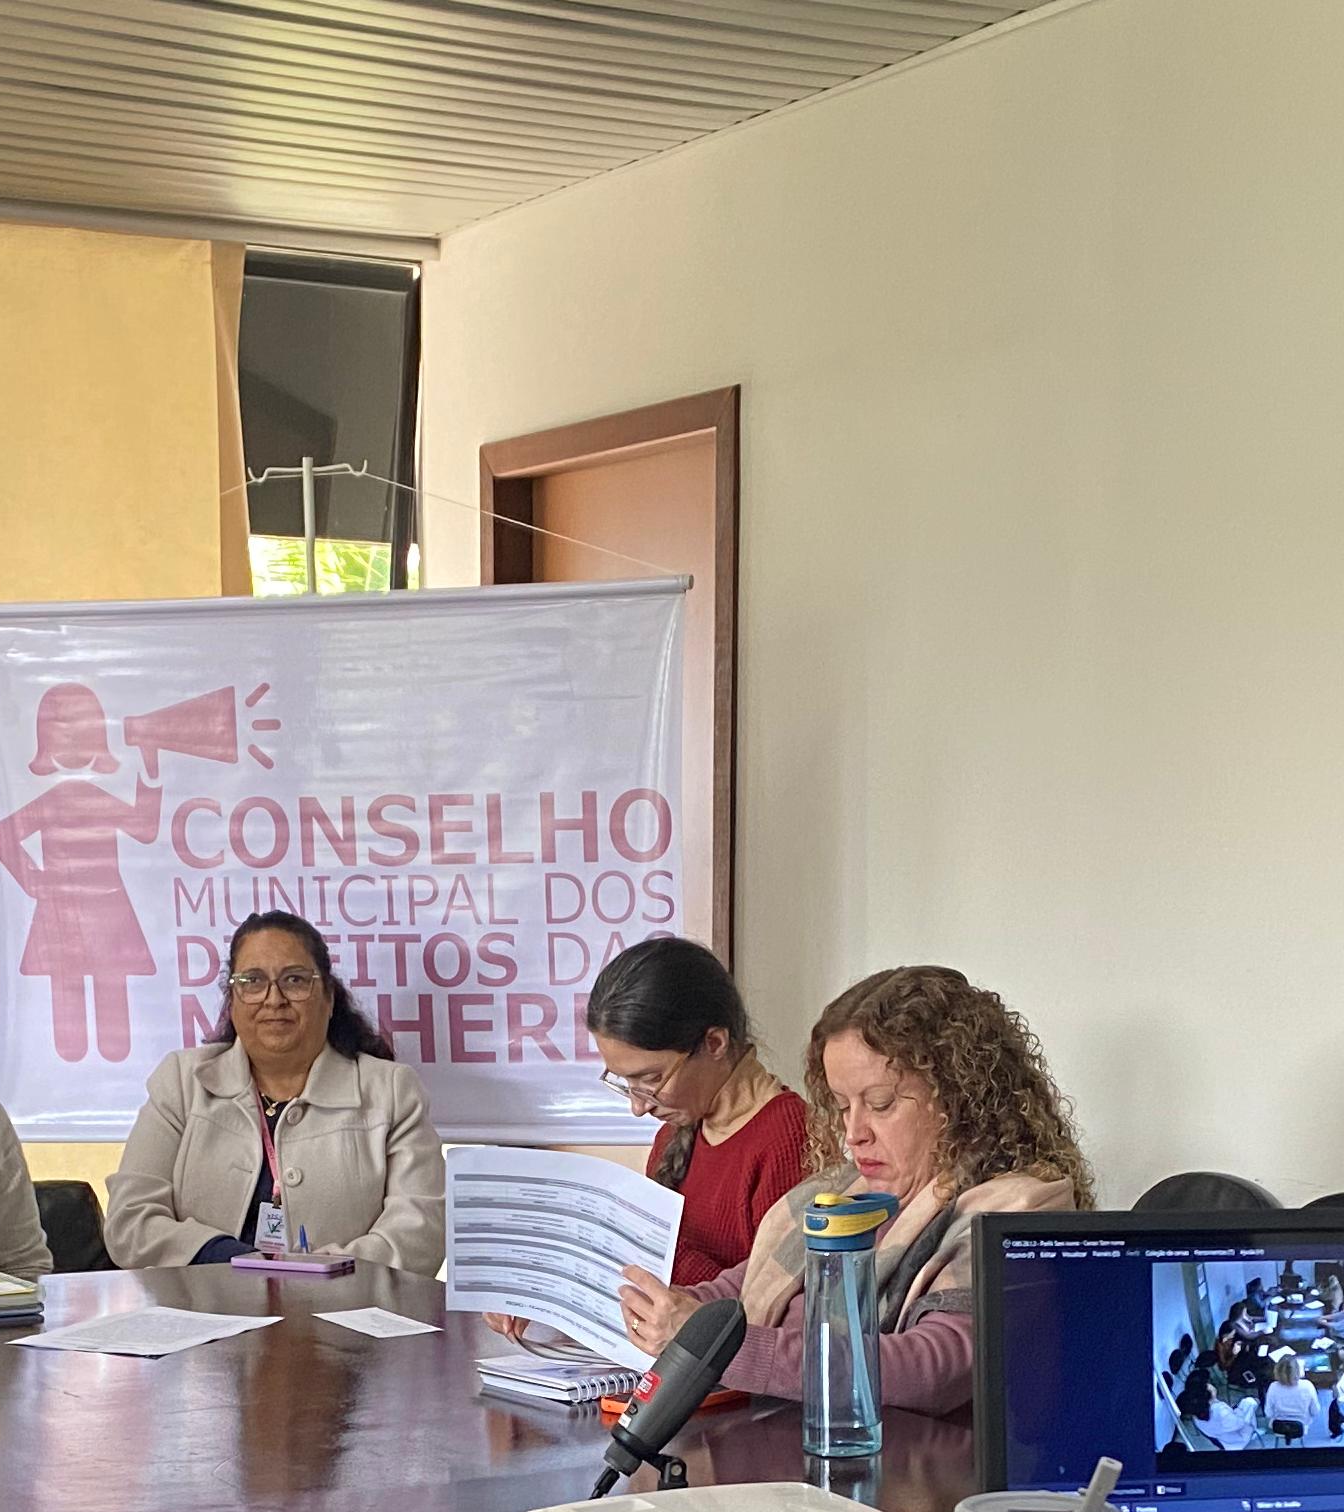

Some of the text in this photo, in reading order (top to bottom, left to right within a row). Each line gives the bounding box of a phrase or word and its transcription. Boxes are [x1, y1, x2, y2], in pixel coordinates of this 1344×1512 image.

[171, 787, 673, 869] CONSELHO
[173, 869, 675, 928] MUNICIPAL DOS
